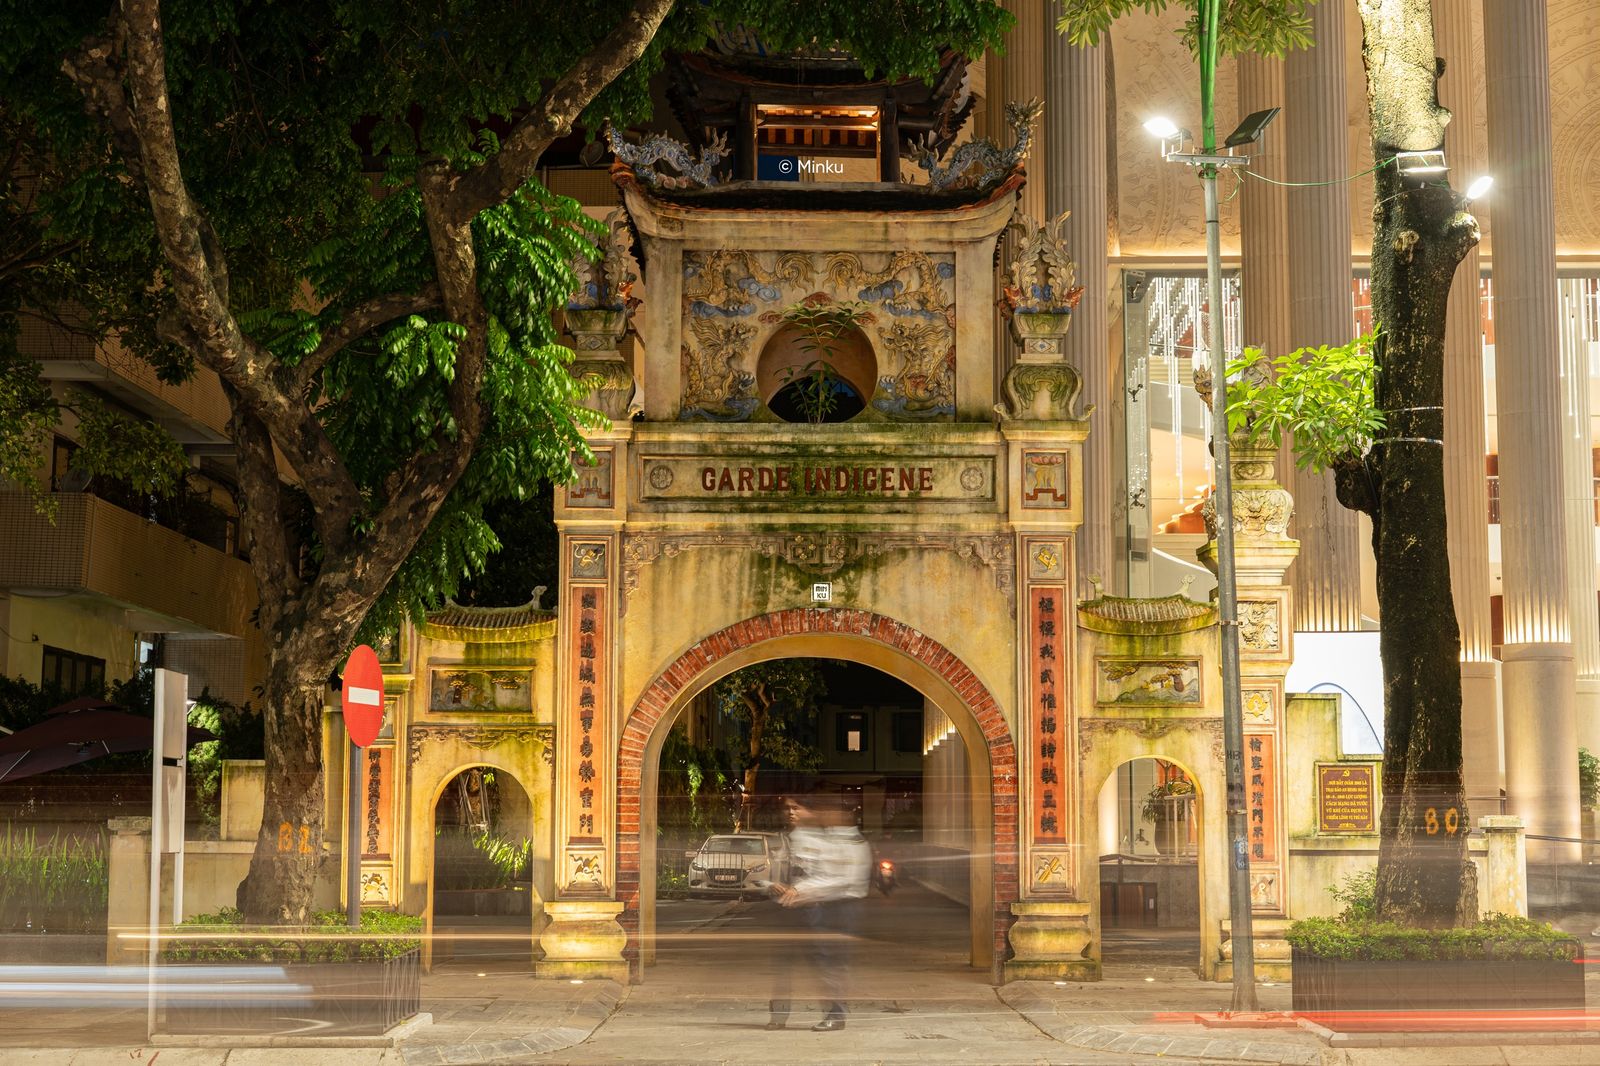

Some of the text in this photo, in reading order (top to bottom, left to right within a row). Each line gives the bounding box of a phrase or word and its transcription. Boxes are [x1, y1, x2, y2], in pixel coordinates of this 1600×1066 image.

[701, 466, 934, 492] GARDE INDIGENE
[1424, 807, 1459, 835] 80
